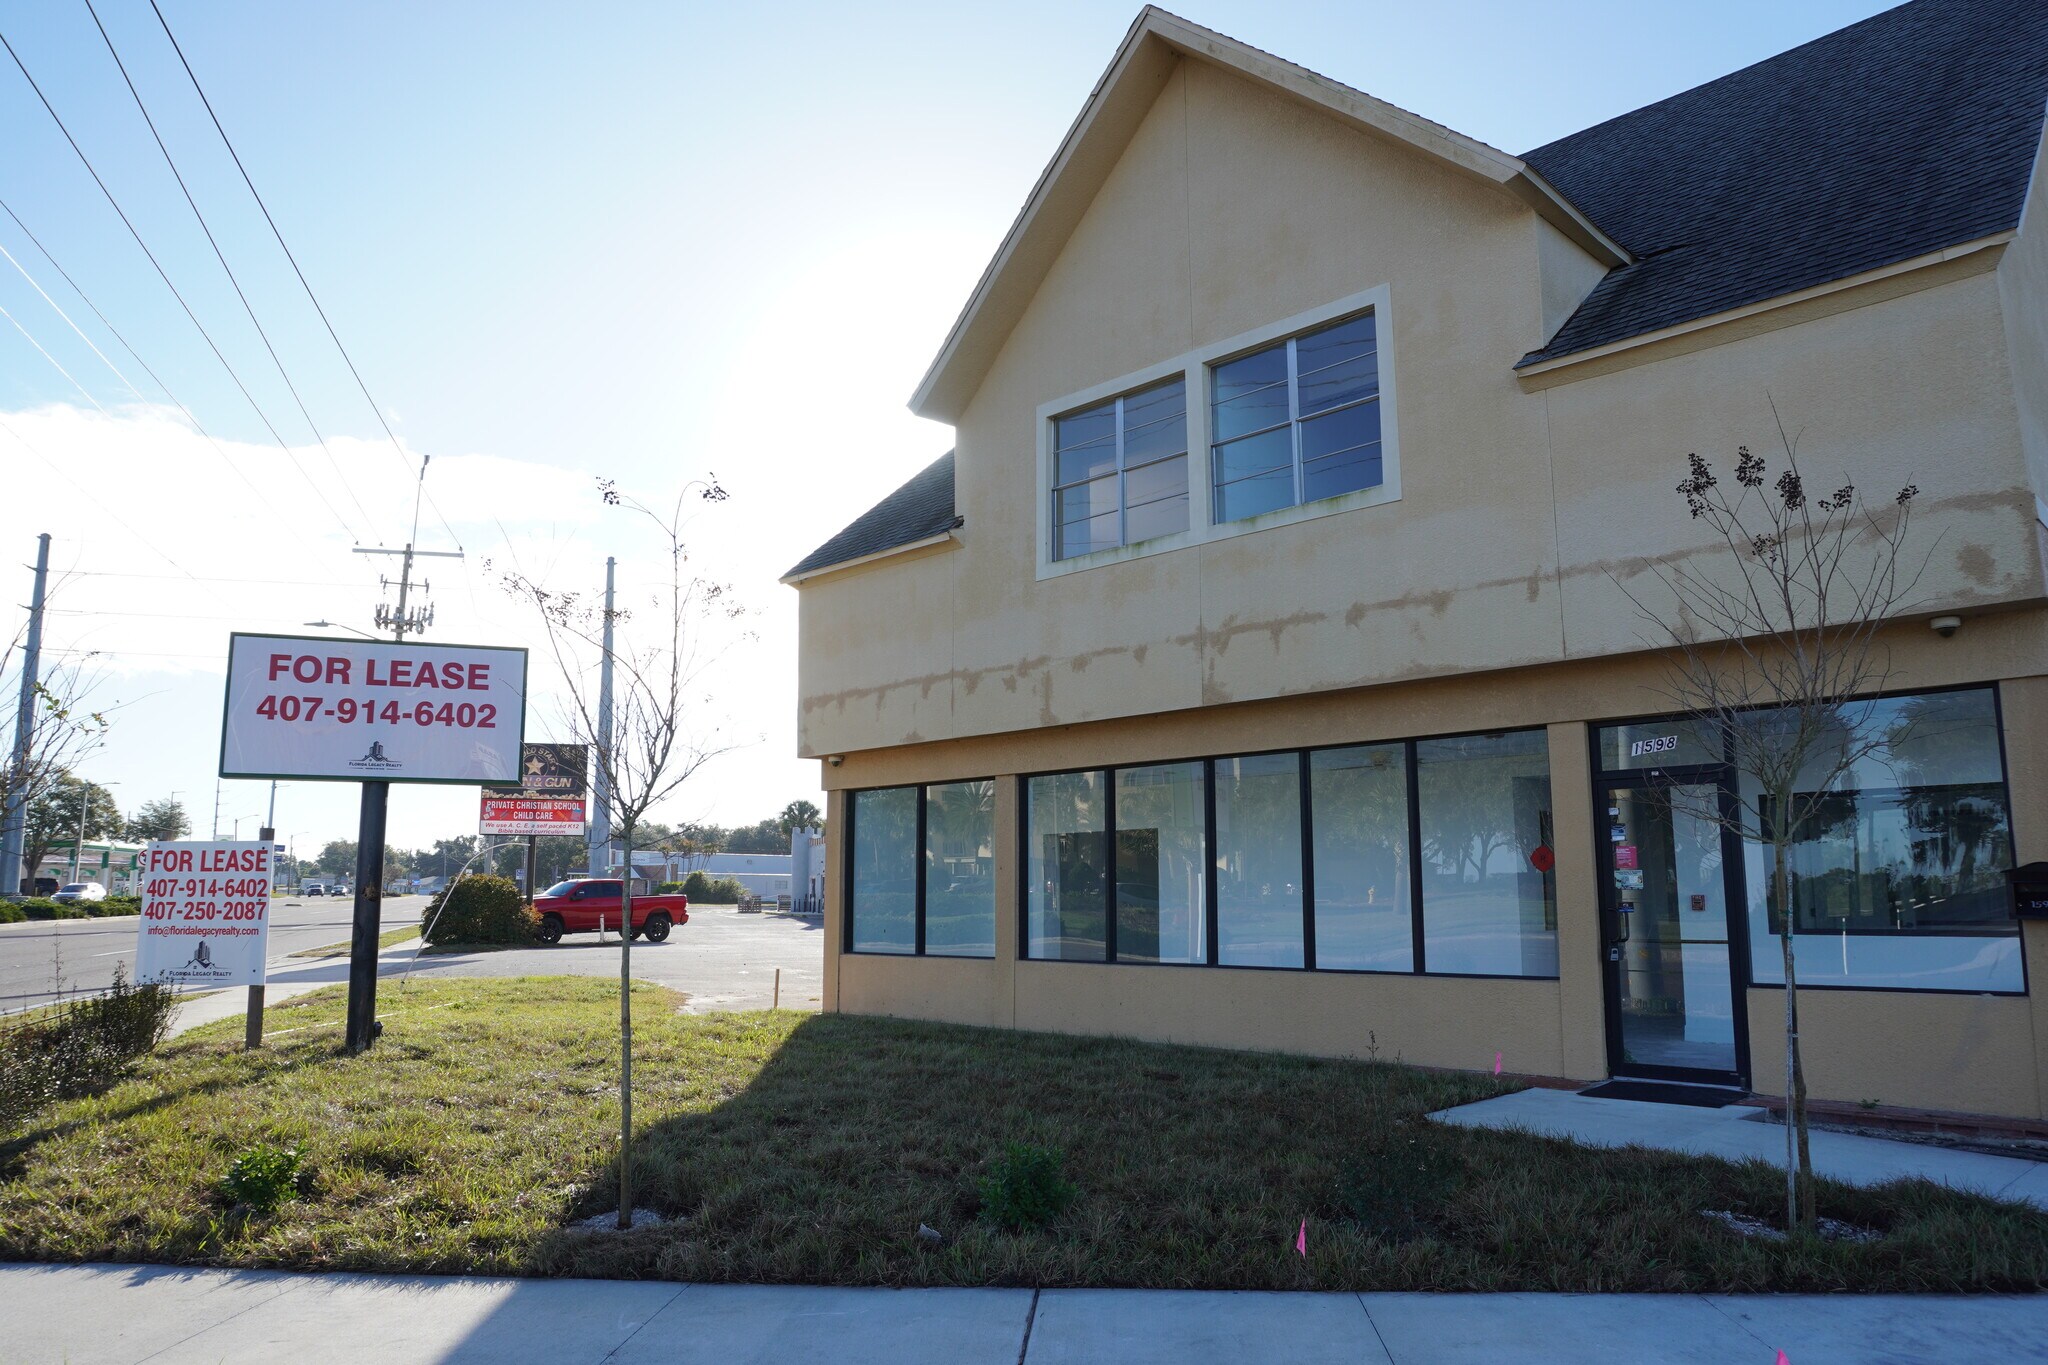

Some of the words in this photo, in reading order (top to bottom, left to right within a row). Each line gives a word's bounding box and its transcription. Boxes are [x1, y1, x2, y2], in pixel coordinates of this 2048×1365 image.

[268, 654, 352, 685] FOR
[365, 659, 491, 690] LEASE
[256, 695, 498, 729] 407-914-6402
[1634, 736, 1676, 755] 1598
[533, 777, 542, 787] &
[544, 777, 572, 788] GUN
[486, 801, 515, 809] PRIVATE
[516, 801, 552, 810] CHRISTIAN
[553, 802, 581, 810] SCHOOL
[513, 811, 534, 819] CHILD
[535, 811, 554, 820] CARE
[548, 823, 567, 831] paced
[149, 849, 193, 872] FOR
[200, 849, 269, 872] LEASE
[146, 878, 268, 897] 407-914-6402
[144, 901, 267, 920] 407-250-2087
[147, 925, 260, 938] info@floridalegacyrealty.com
